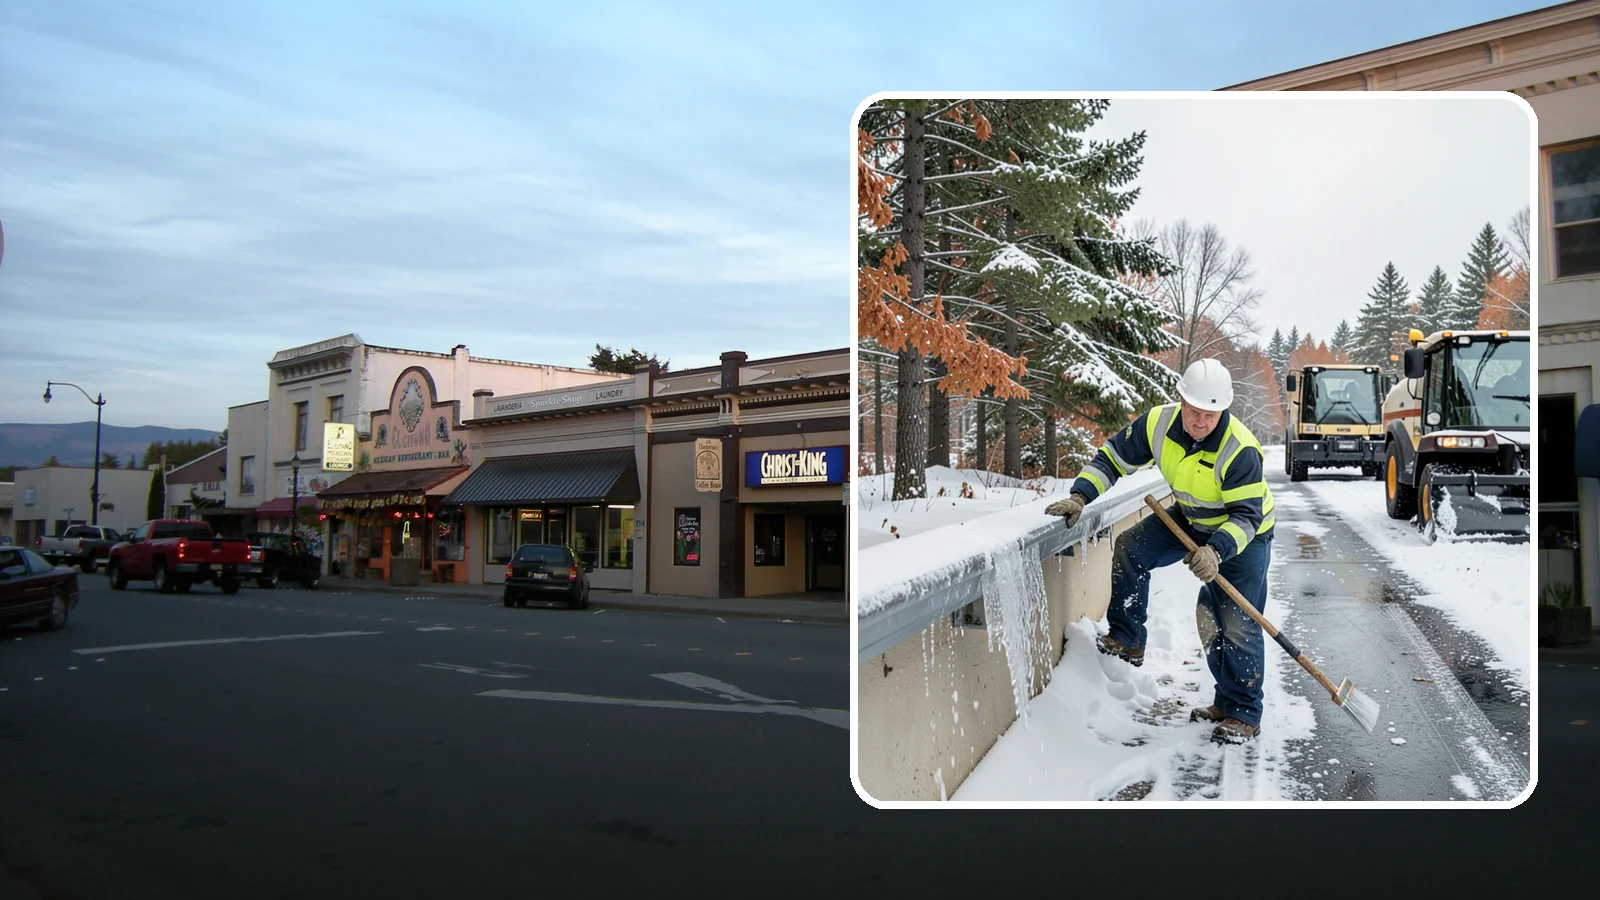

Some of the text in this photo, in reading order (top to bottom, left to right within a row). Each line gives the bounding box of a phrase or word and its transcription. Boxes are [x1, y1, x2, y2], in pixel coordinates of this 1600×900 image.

[596, 389, 623, 400] LAUNDRY
[493, 402, 522, 412] LAVANDERIA
[531, 395, 582, 409] Sparkle Shop
[373, 455, 396, 464] MEXICAN
[397, 452, 433, 463] RESTAURANT
[438, 450, 450, 459] BAR
